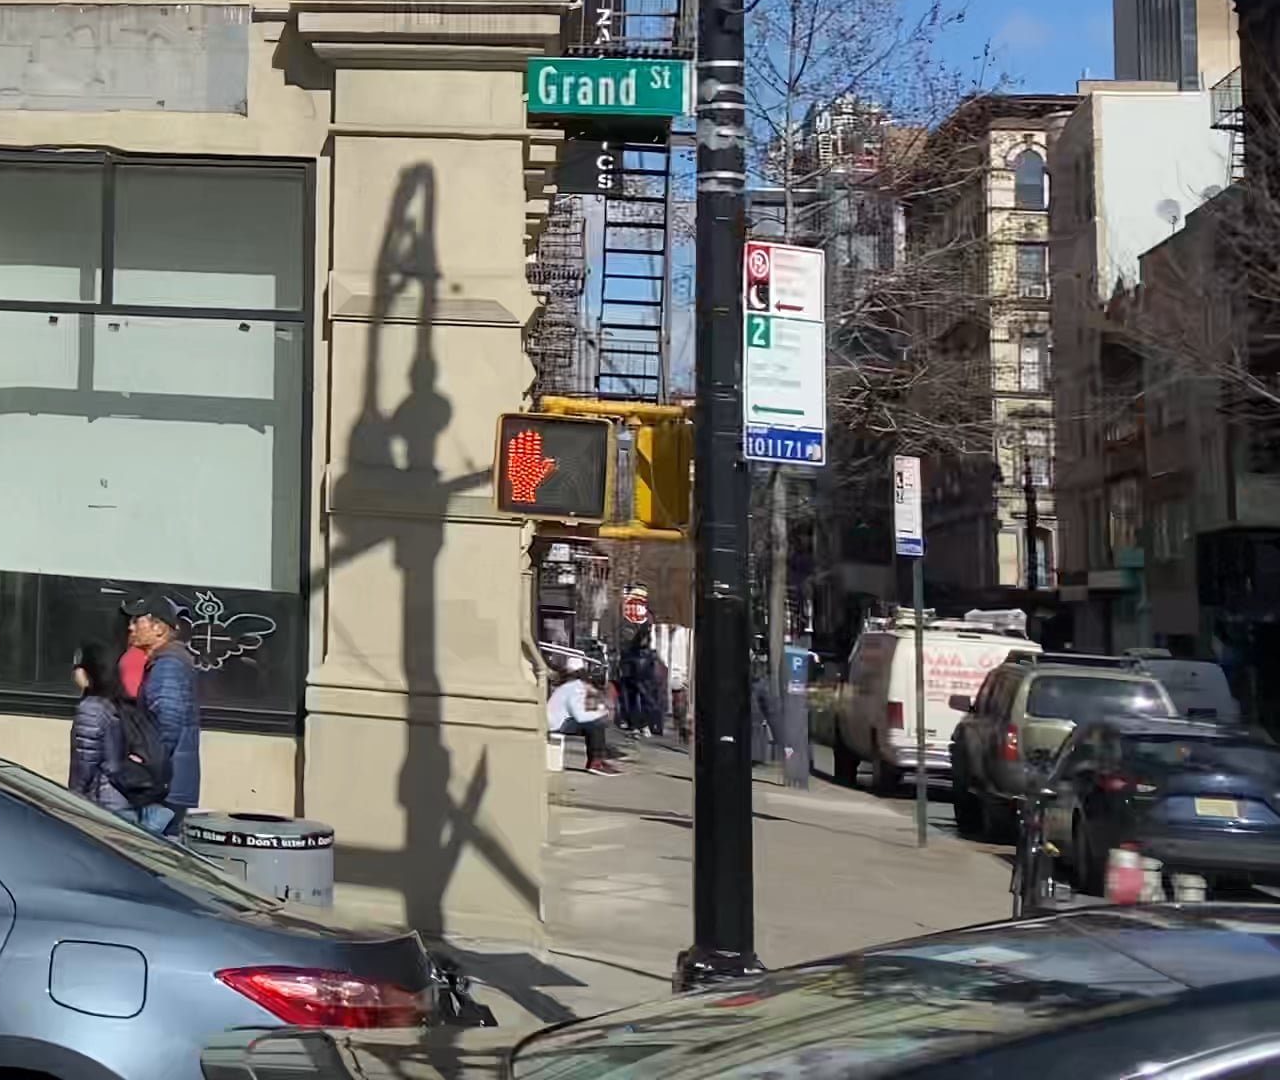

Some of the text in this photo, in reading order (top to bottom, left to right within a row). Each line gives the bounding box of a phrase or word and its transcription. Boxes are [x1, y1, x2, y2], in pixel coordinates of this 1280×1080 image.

[538, 65, 672, 106] Grand St
[752, 317, 766, 346] 2
[246, 837, 279, 848] Don't
